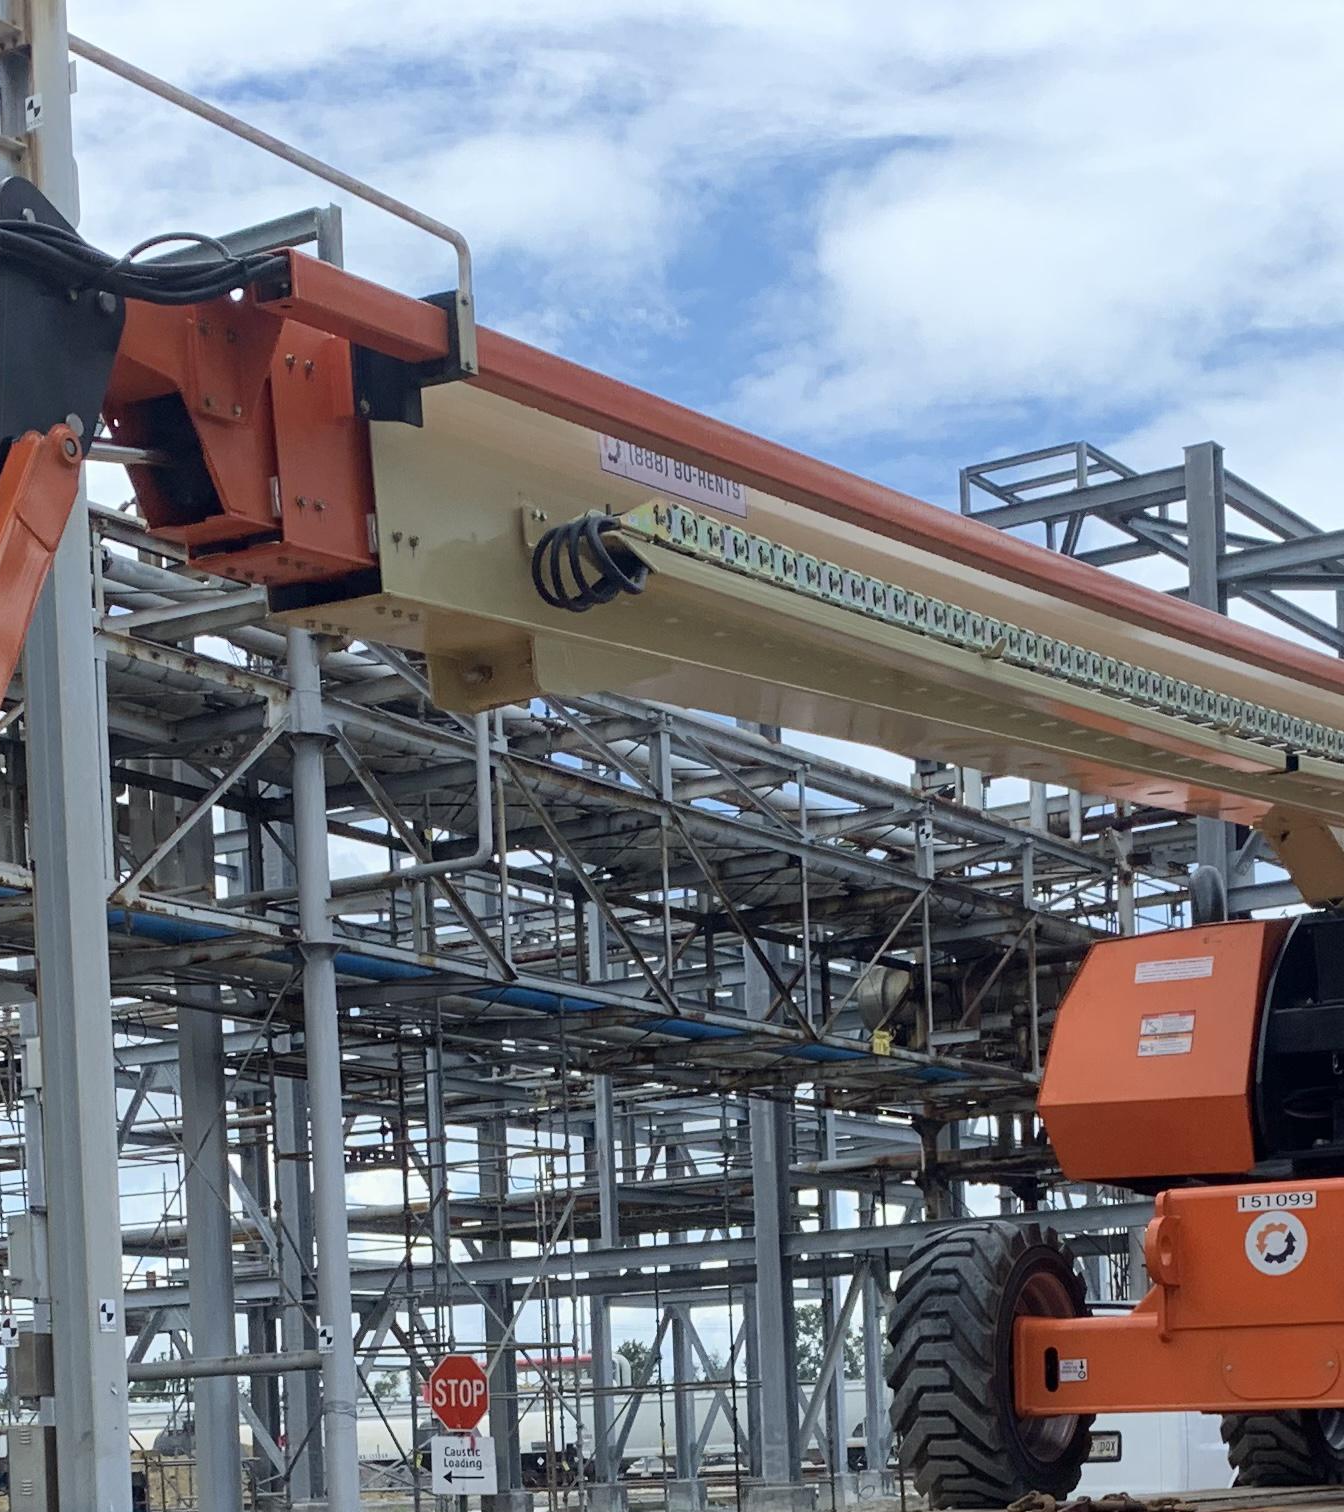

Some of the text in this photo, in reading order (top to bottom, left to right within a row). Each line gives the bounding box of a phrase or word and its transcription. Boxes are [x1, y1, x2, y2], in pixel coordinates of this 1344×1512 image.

[1240, 1192, 1313, 1209] 151099
[434, 1378, 485, 1408] STOP
[444, 1446, 481, 1457] Caustic
[443, 1458, 483, 1471] Loading
